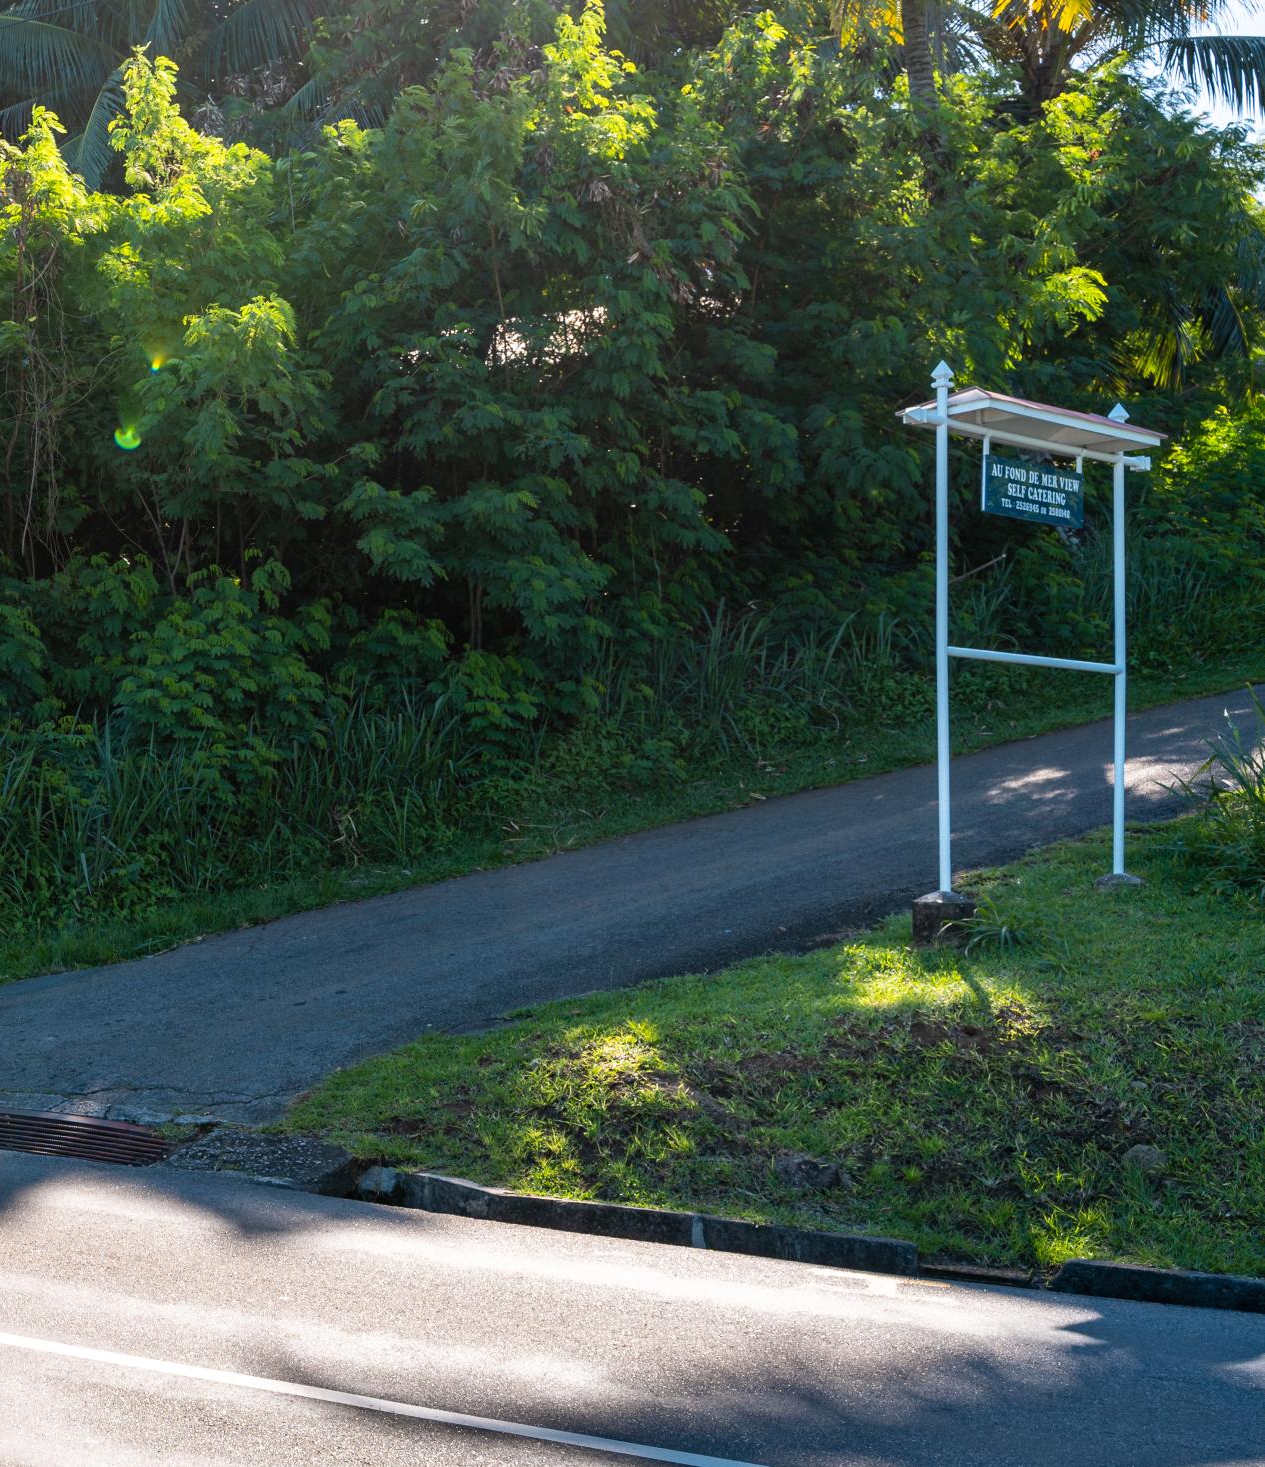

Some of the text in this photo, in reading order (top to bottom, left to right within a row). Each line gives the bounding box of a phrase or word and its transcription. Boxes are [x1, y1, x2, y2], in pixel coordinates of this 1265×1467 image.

[991, 463, 1080, 493] AU FOND DE MER VIEW
[1007, 482, 1066, 506] SELF CATERING
